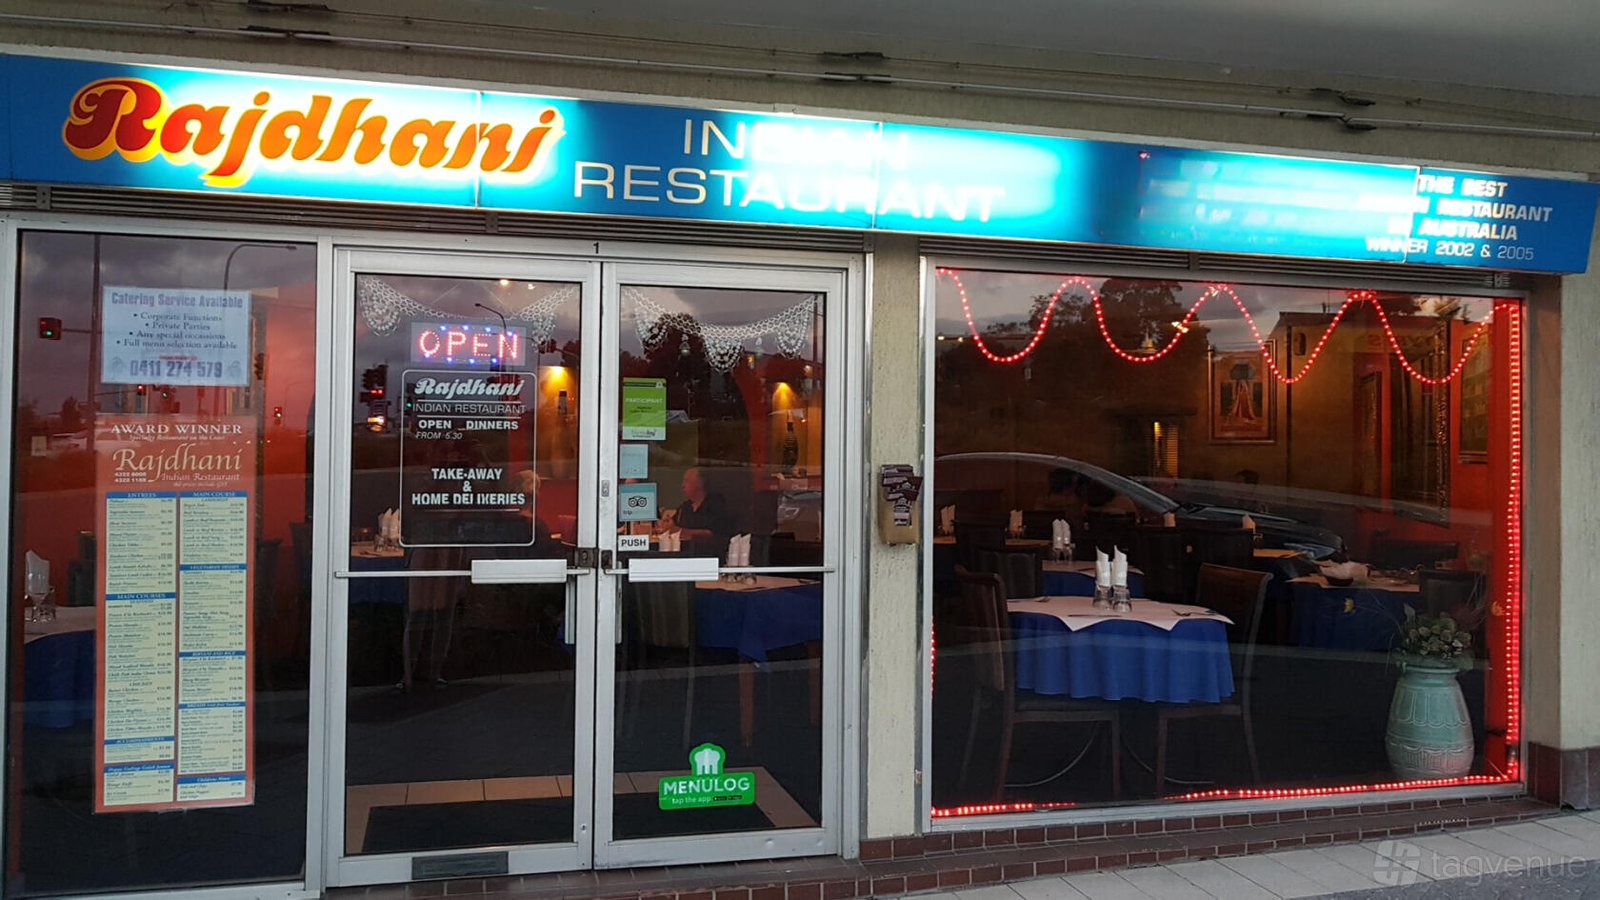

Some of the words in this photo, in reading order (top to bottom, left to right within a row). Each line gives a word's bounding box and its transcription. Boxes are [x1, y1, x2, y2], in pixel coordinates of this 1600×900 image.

[62, 77, 565, 187] Rajdhani
[684, 119, 909, 169] INAN
[574, 161, 1005, 222] RESTAURANT
[1419, 175, 1455, 194] THE
[1461, 179, 1508, 197] BEST
[1437, 198, 1553, 222] RESTAURANT
[1418, 219, 1518, 240] AUSTRALIA
[593, 242, 599, 254] 1
[1365, 236, 1428, 254] WINNER
[1435, 241, 1475, 257] 2002
[1480, 244, 1491, 257] &
[1497, 246, 1534, 260] 2005
[112, 292, 155, 307] Catering
[158, 294, 196, 306] Service
[200, 295, 243, 308] Available
[140, 312, 179, 322] Corporate
[183, 313, 222, 322] Functions
[152, 321, 180, 330] Private
[183, 322, 210, 331] Parties
[136, 330, 153, 339] Any
[156, 331, 182, 340] special
[124, 338, 140, 347] Full
[167, 340, 201, 348] selection
[203, 341, 237, 349] available
[419, 330, 518, 358] OPEN
[130, 360, 161, 377] 0411
[166, 361, 192, 377] 274
[414, 378, 524, 400] Rajdhani
[413, 404, 451, 413] INDIAN
[455, 404, 526, 414] RESTAURANT
[111, 424, 169, 434] AWARD
[175, 424, 242, 434] WINNER
[419, 420, 451, 429] OPEN
[466, 420, 519, 430] DINNERS
[415, 432, 441, 440] FROM
[113, 443, 243, 482] Rajdhani
[160, 472, 190, 481] Indian
[193, 472, 240, 481] Restaurant
[462, 481, 472, 492] &
[412, 493, 449, 505] HOME
[621, 539, 647, 547] PUSH
[664, 778, 750, 795] MENULOG
